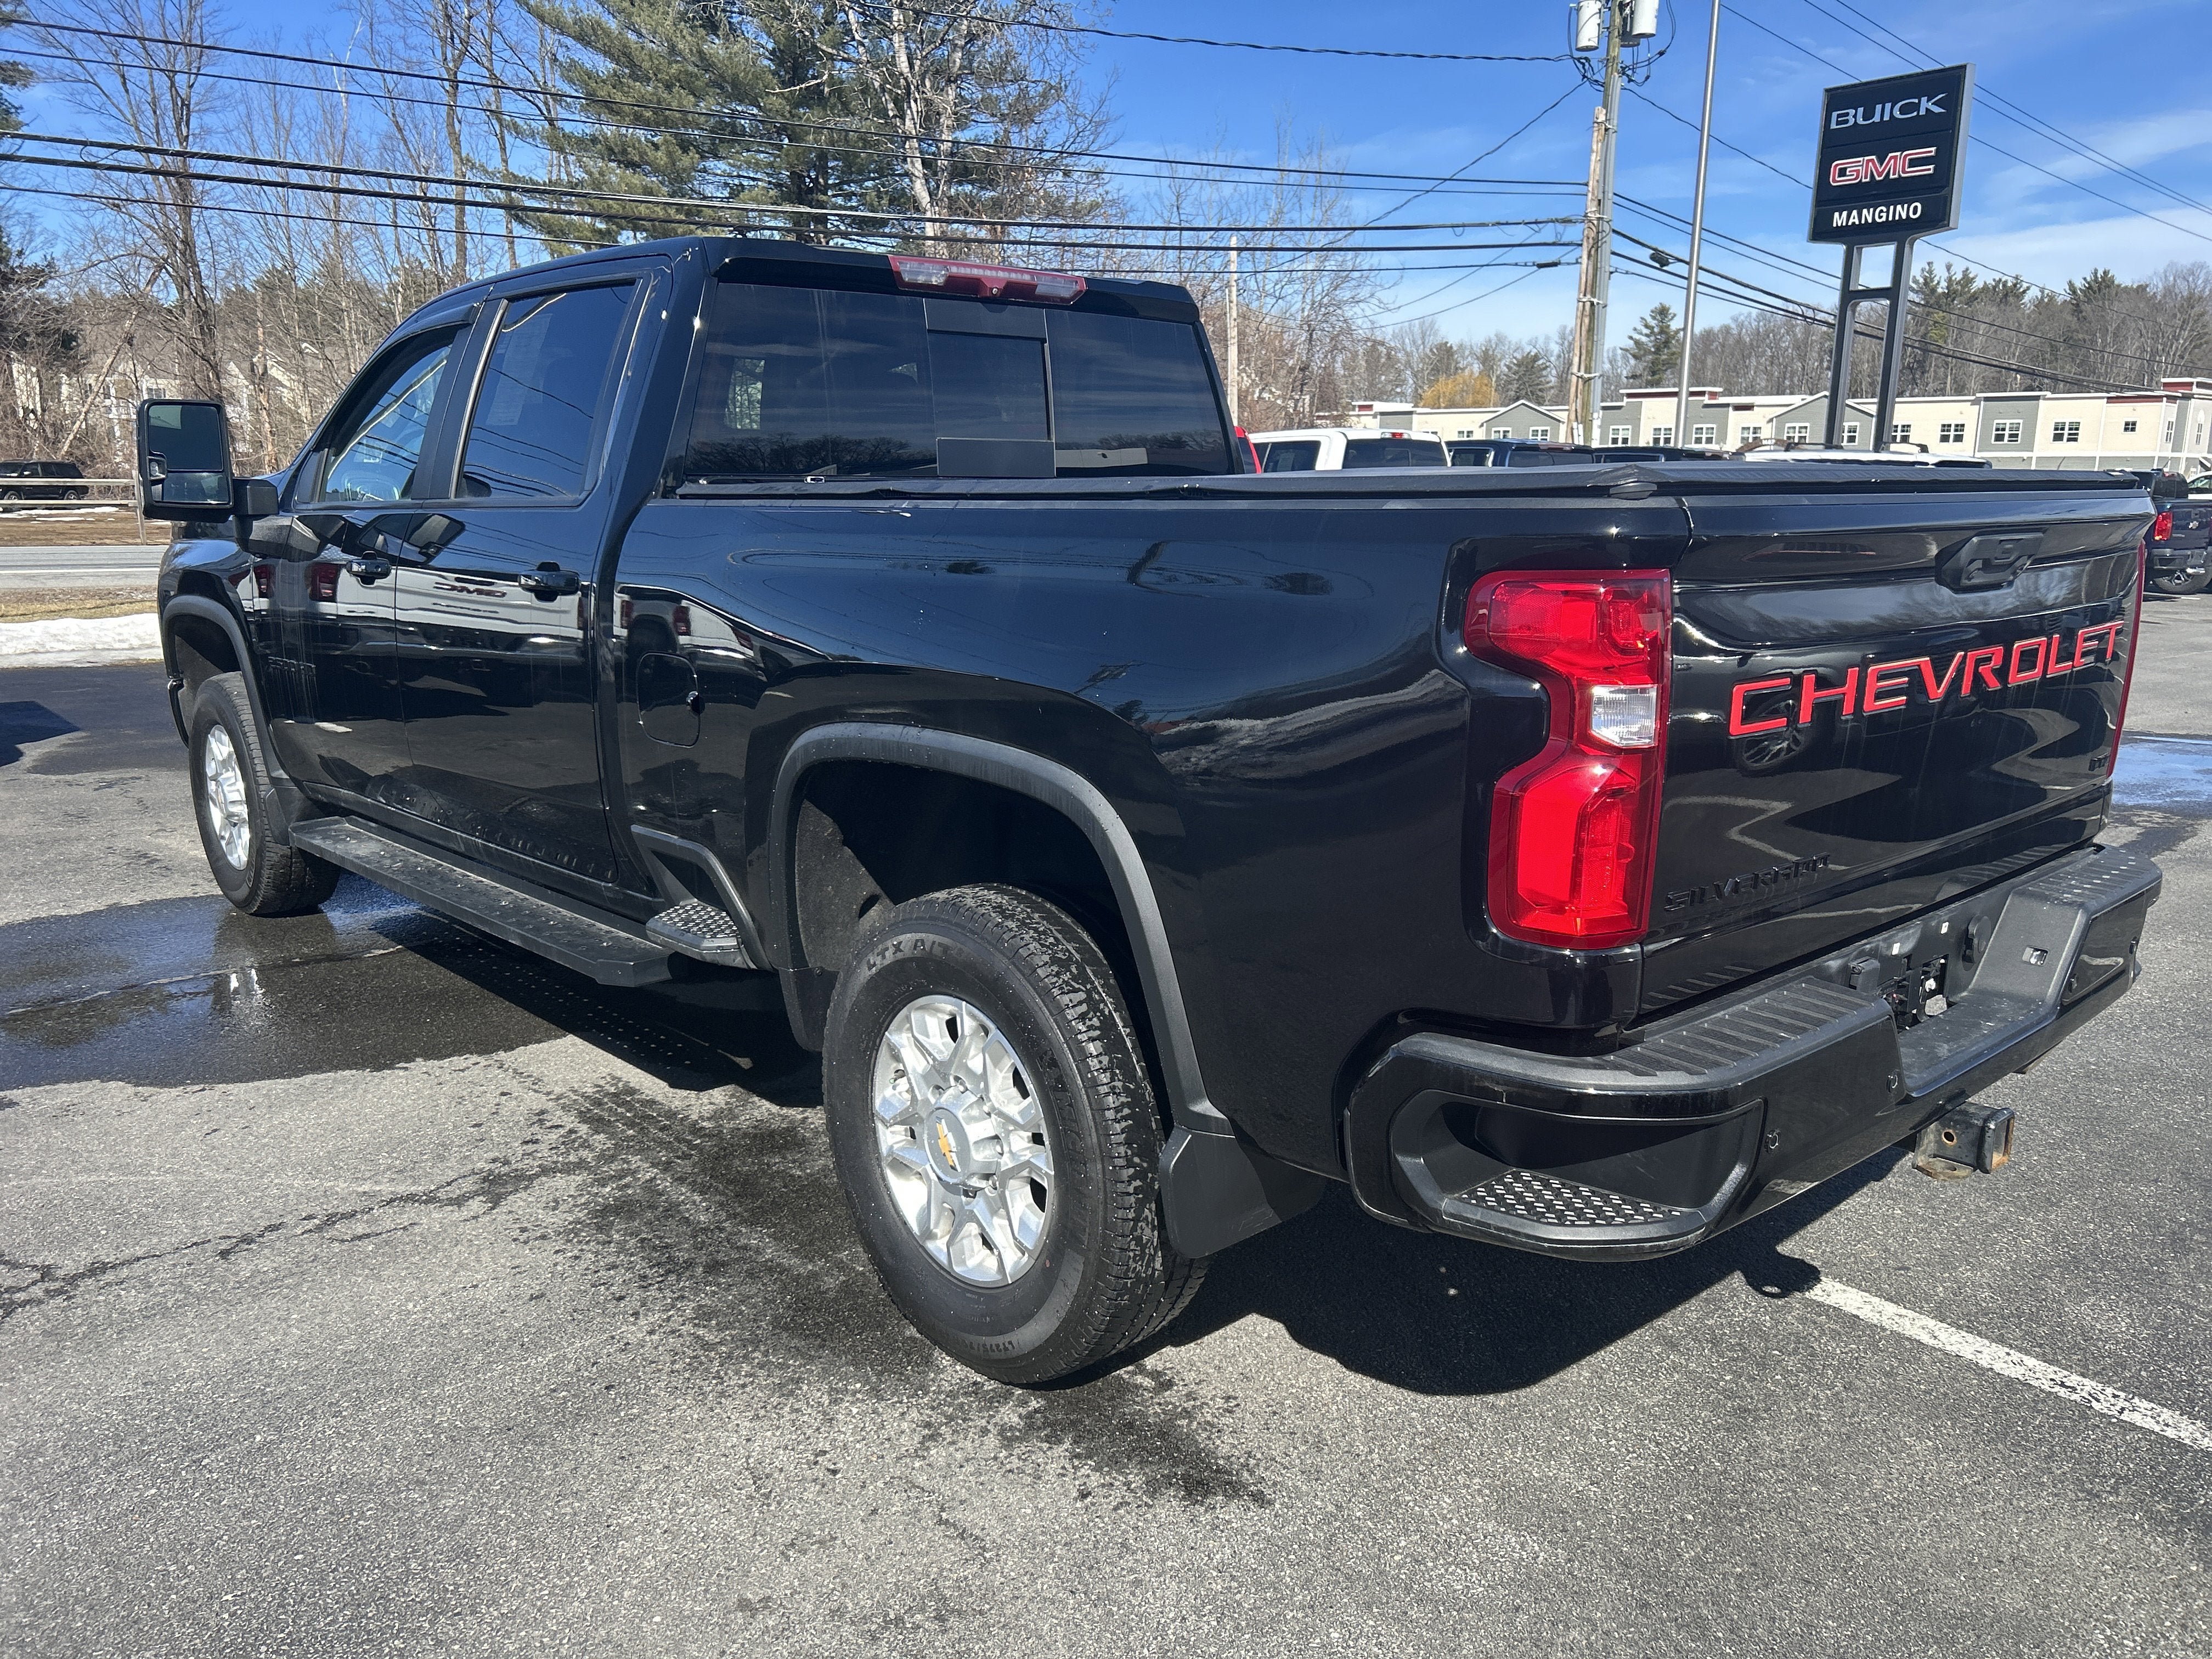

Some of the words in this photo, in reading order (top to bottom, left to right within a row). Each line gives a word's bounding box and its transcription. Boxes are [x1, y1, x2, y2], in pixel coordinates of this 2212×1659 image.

[1830, 93, 1948, 129] BUICK
[1830, 147, 1937, 186] GMC
[1832, 202, 1921, 227] MANGINO
[1729, 620, 2124, 737] CHEVROLET
